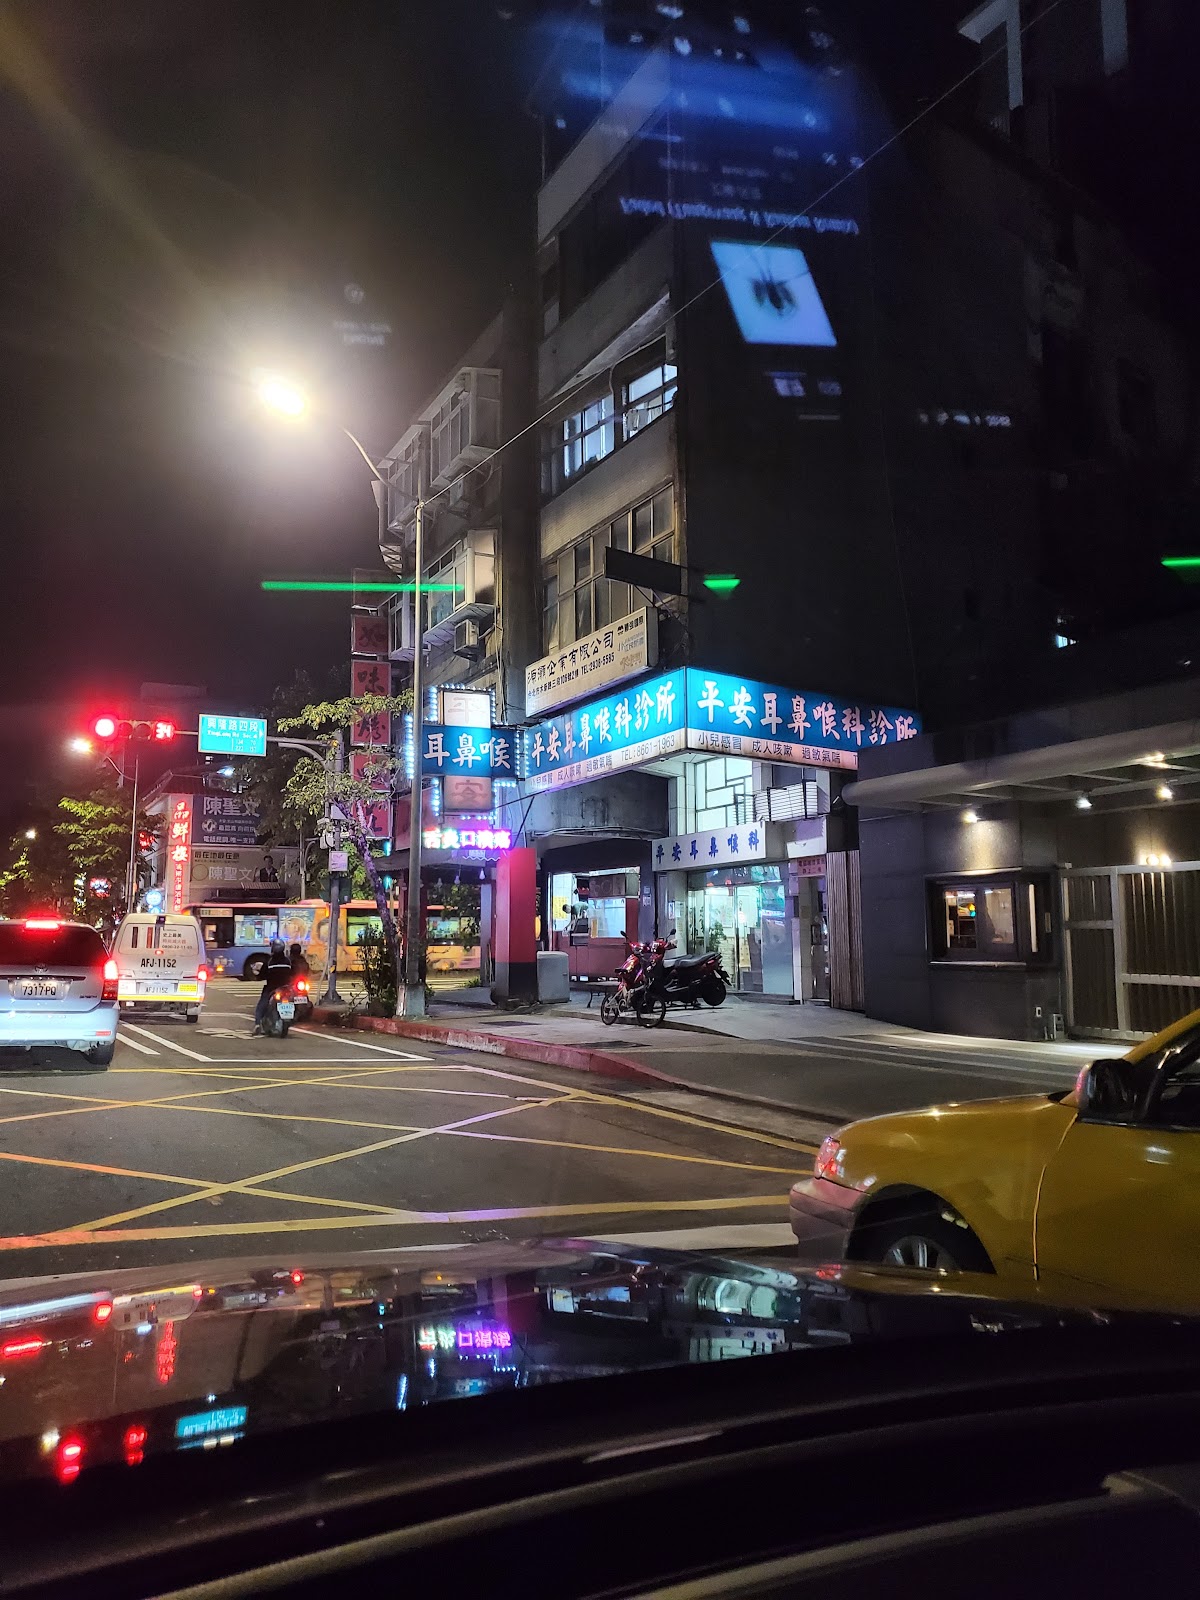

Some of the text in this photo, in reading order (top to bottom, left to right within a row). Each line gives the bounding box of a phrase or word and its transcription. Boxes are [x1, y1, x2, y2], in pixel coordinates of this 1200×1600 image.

[531, 681, 676, 768] 平安耳鼻喉科診所
[697, 680, 920, 746] 平安耳鼻喉科診所
[424, 733, 511, 769] 耳鼻喉
[698, 732, 742, 751] 小兒感冒
[752, 742, 793, 758] 成人咳嗽
[801, 747, 841, 764] 過敏氣喘
[203, 796, 260, 817] 陳聖文
[452, 779, 488, 807] 安
[656, 829, 760, 864] 平安耳鼻喉科
[208, 866, 253, 881] 陳聖文
[140, 958, 177, 968] AFJ-1152
